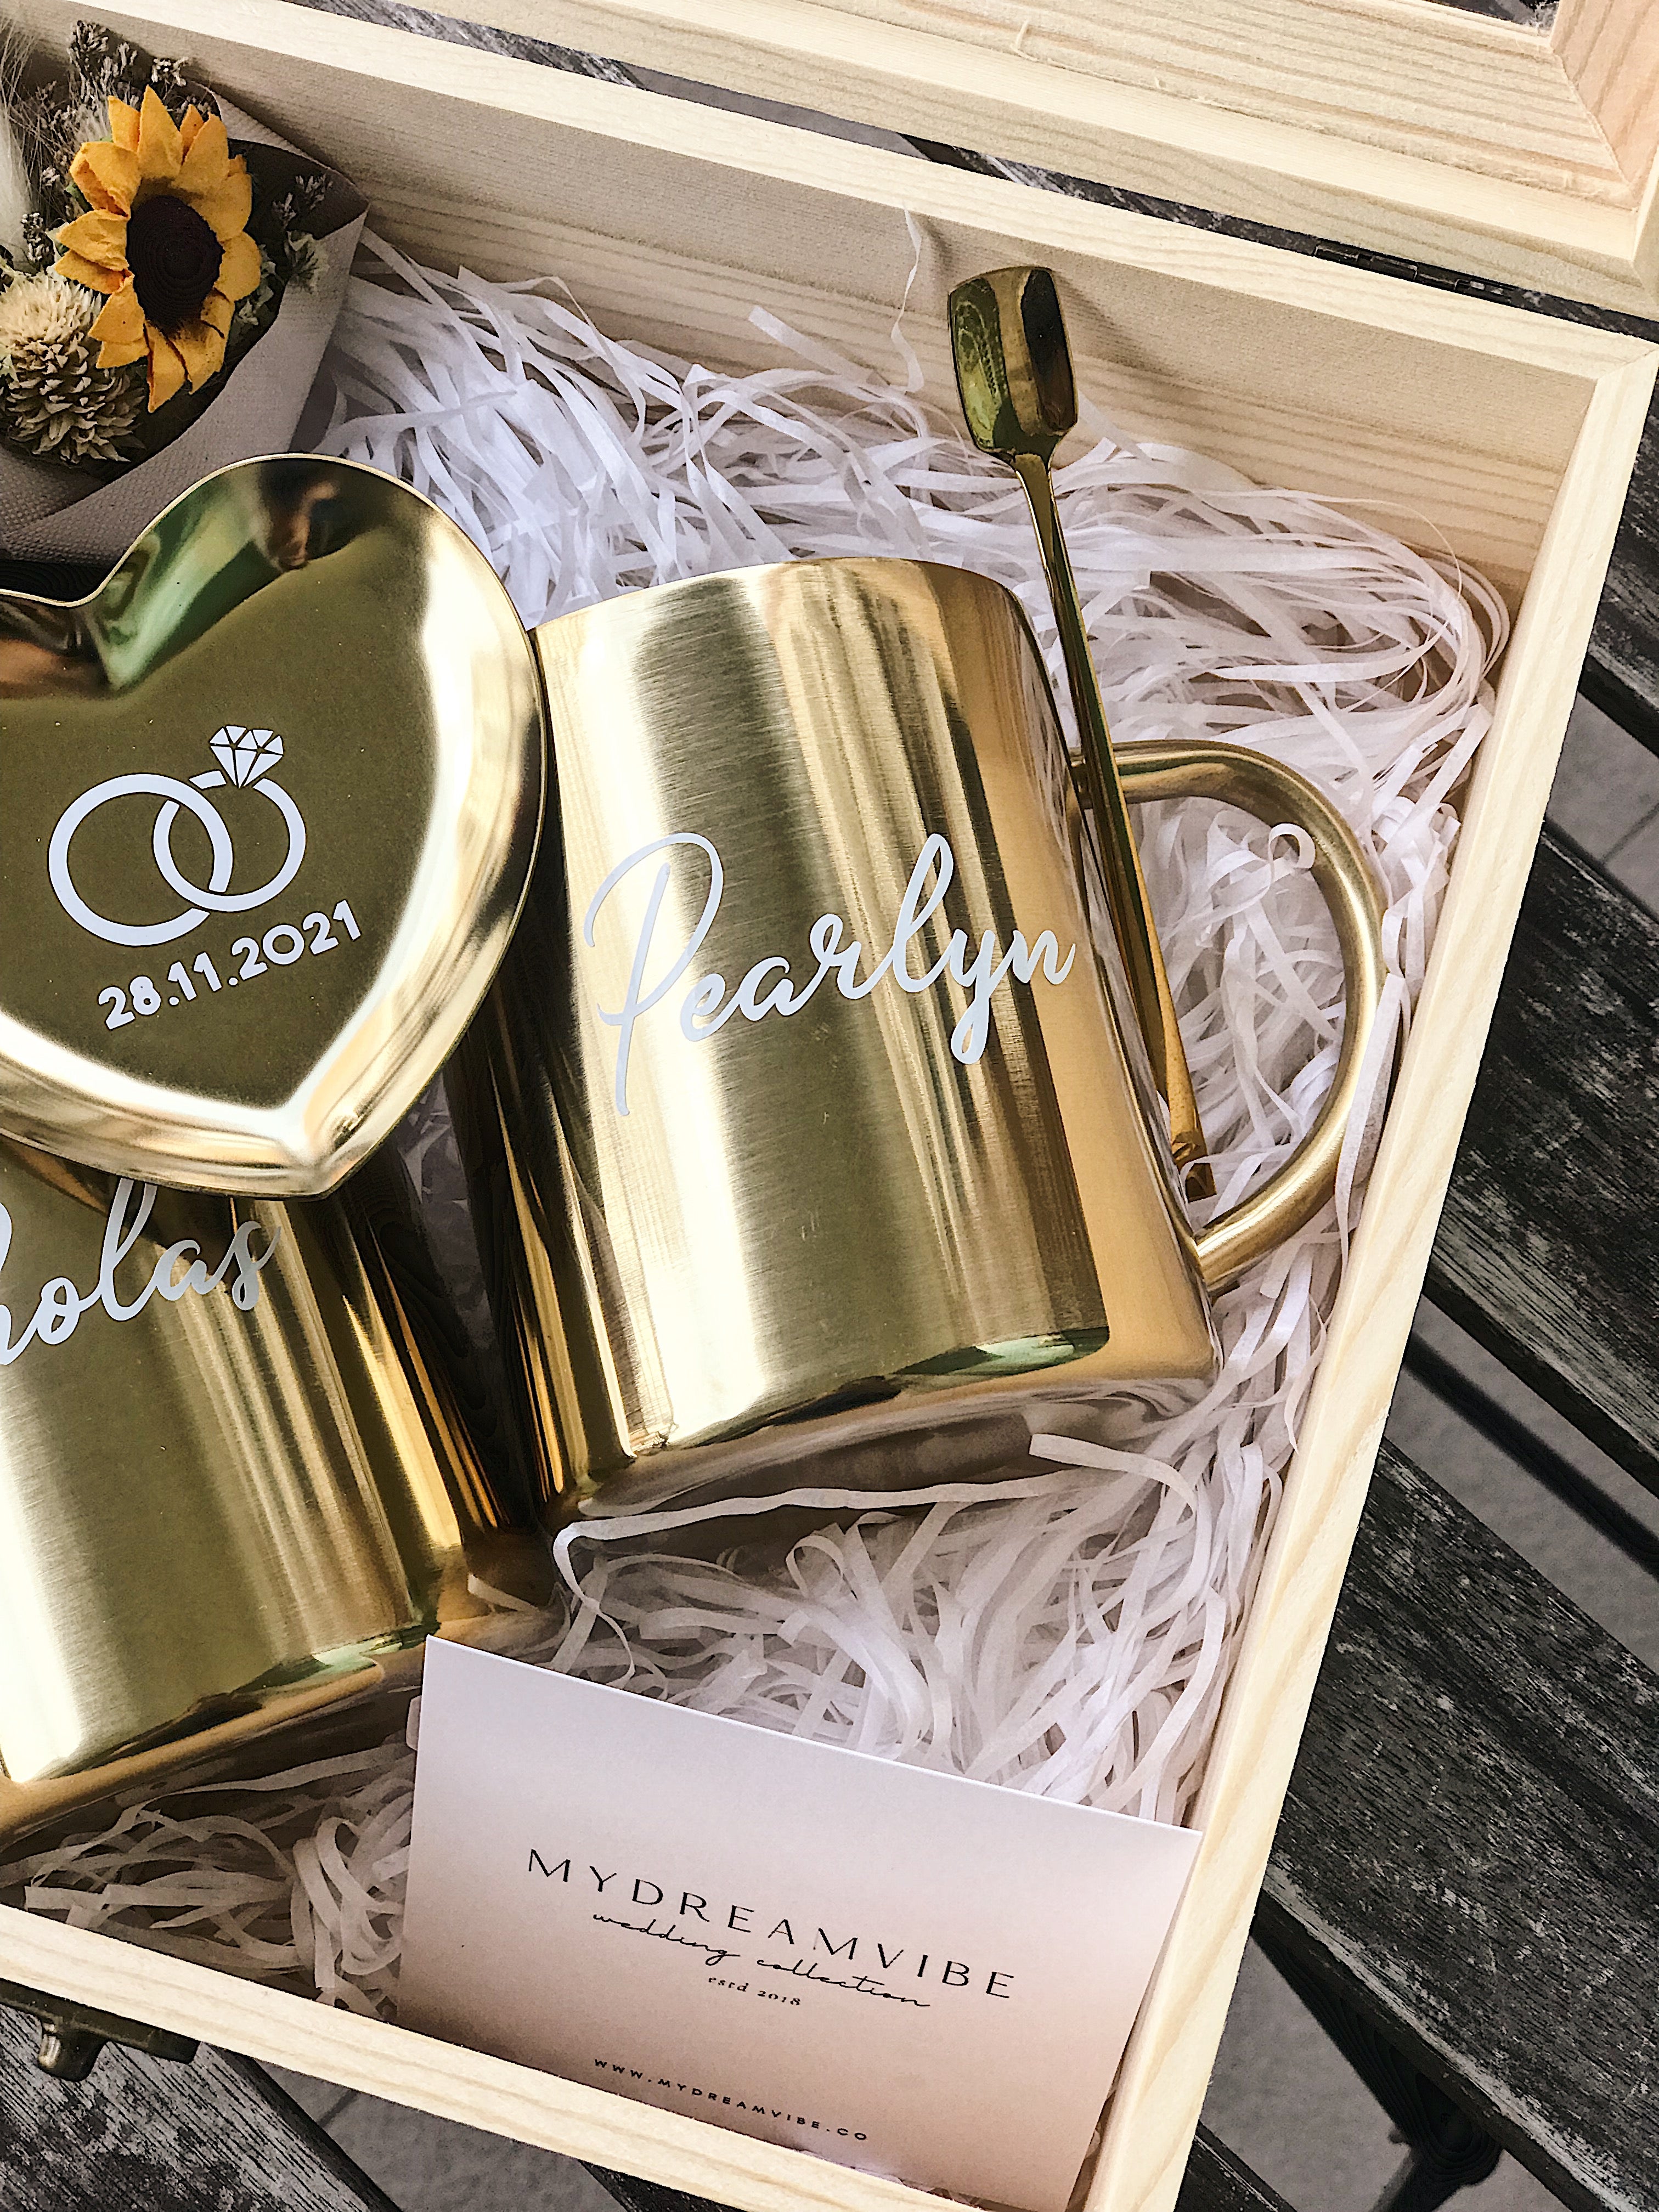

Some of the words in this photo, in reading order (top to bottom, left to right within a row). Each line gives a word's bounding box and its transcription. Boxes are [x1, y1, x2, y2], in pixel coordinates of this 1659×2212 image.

[98, 899, 362, 1030] 28.11.2021
[584, 832, 1075, 1116] Pearlyn
[528, 1848, 1015, 1999] MYDREAMVIBE
[592, 1912, 741, 1966] wedding
[757, 1958, 931, 2008] collection
[757, 1990, 801, 2006] 2018
[594, 2058, 868, 2141] WWW.MYDREAMVIBE.CO
